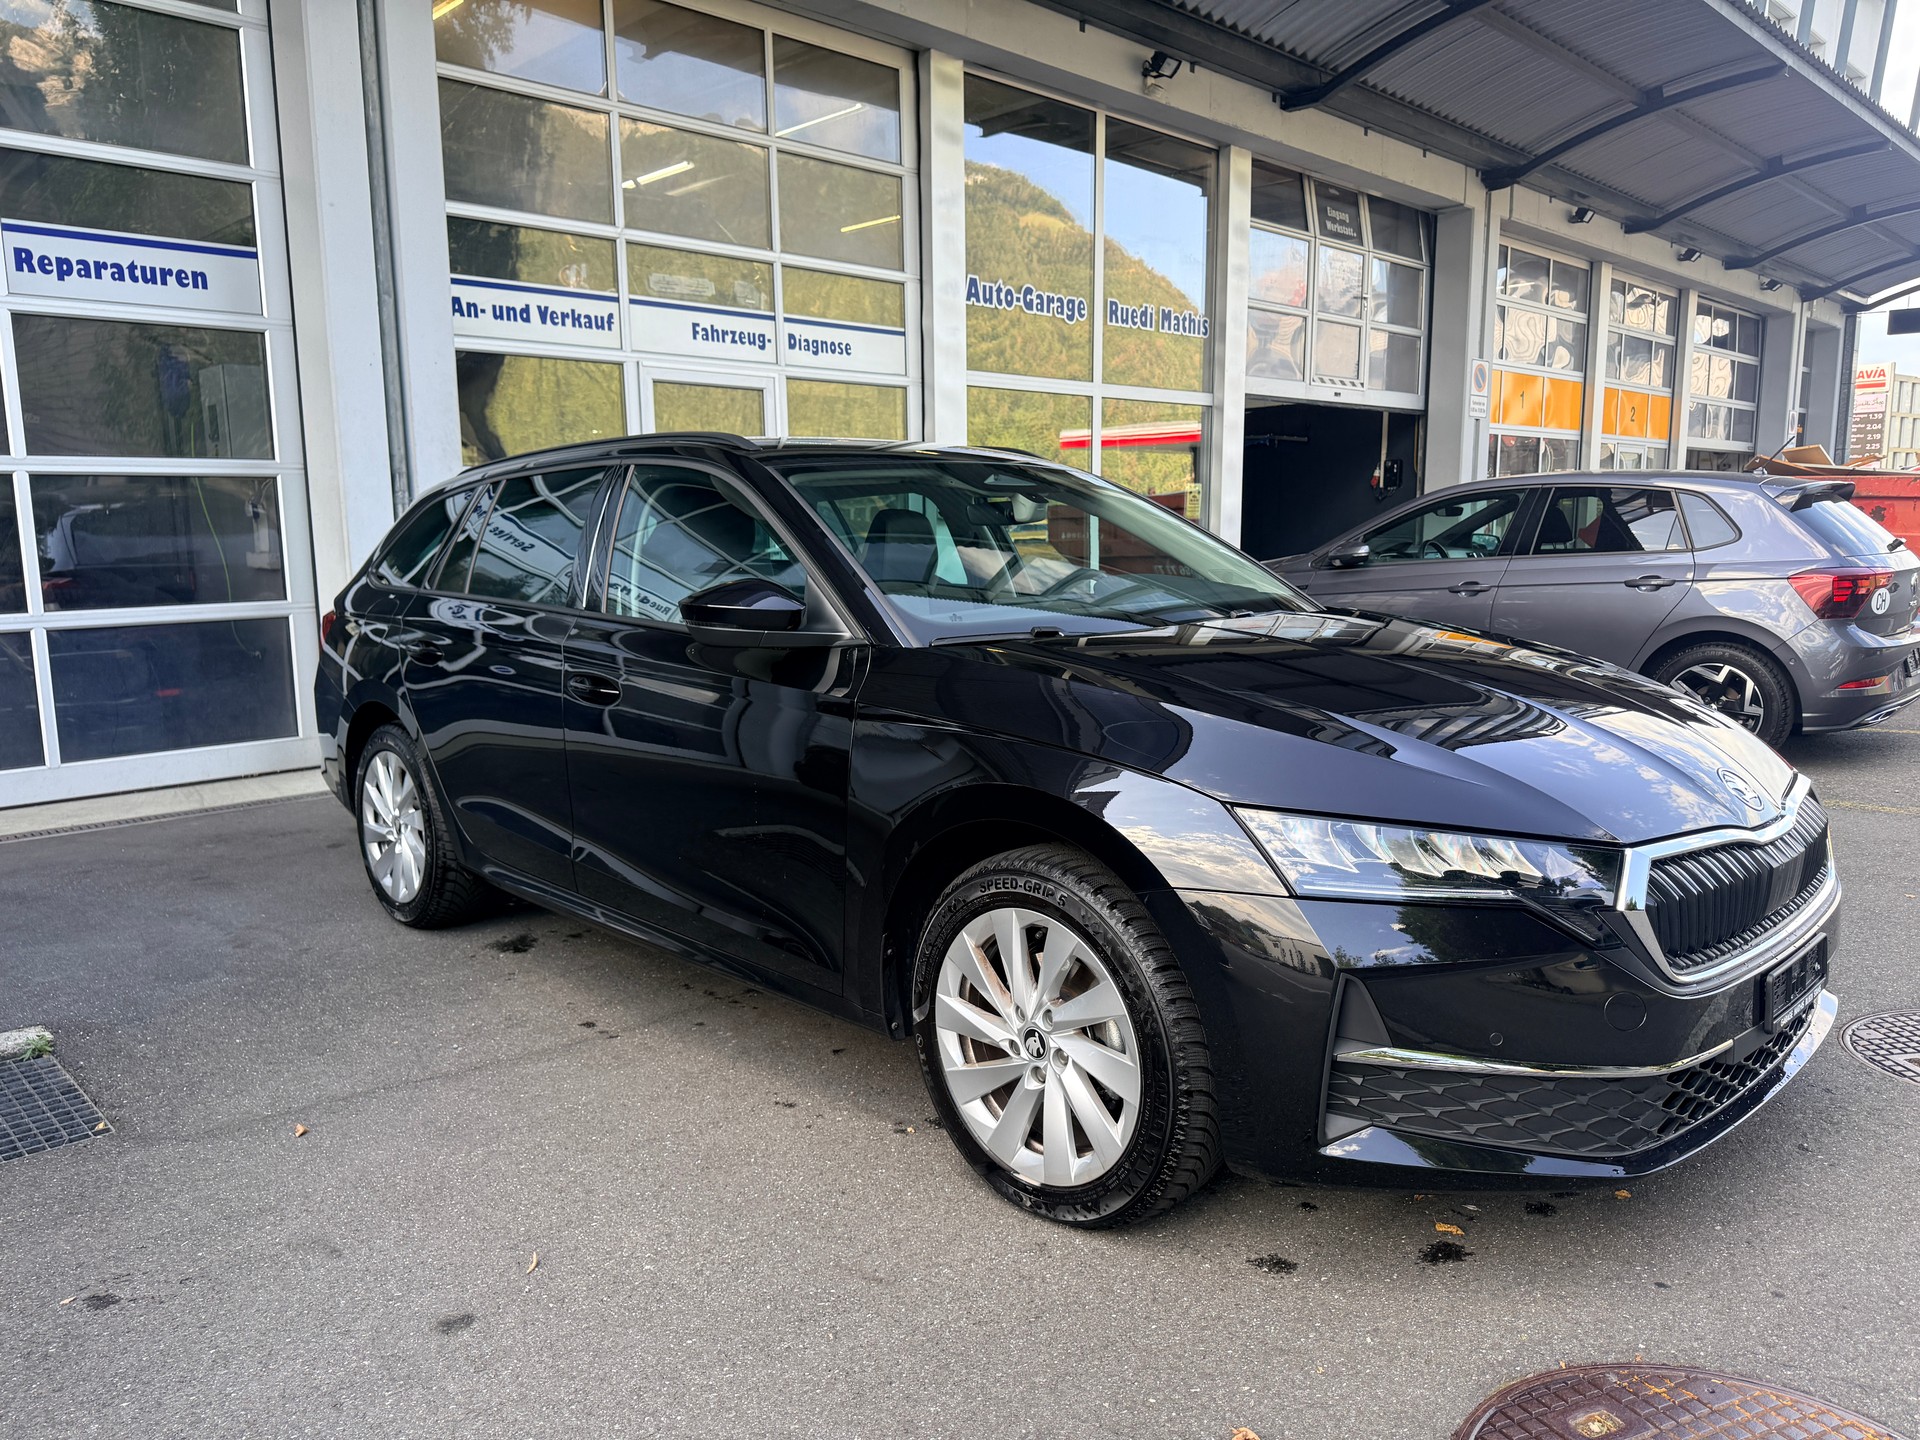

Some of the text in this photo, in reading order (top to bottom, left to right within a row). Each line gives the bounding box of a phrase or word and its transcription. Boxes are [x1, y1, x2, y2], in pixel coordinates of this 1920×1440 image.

[13, 246, 209, 290] Reparaturen
[451, 296, 614, 331] An- und Verkauf
[966, 276, 1210, 338] Auto-Garage Ruedi Mathis
[691, 322, 852, 356] Fahrzeug- Diagnose
[1520, 390, 1525, 409] 1
[1630, 406, 1636, 422] 2
[1876, 592, 1887, 611] CH
[979, 877, 1068, 907] SPEED-GRIP 5
